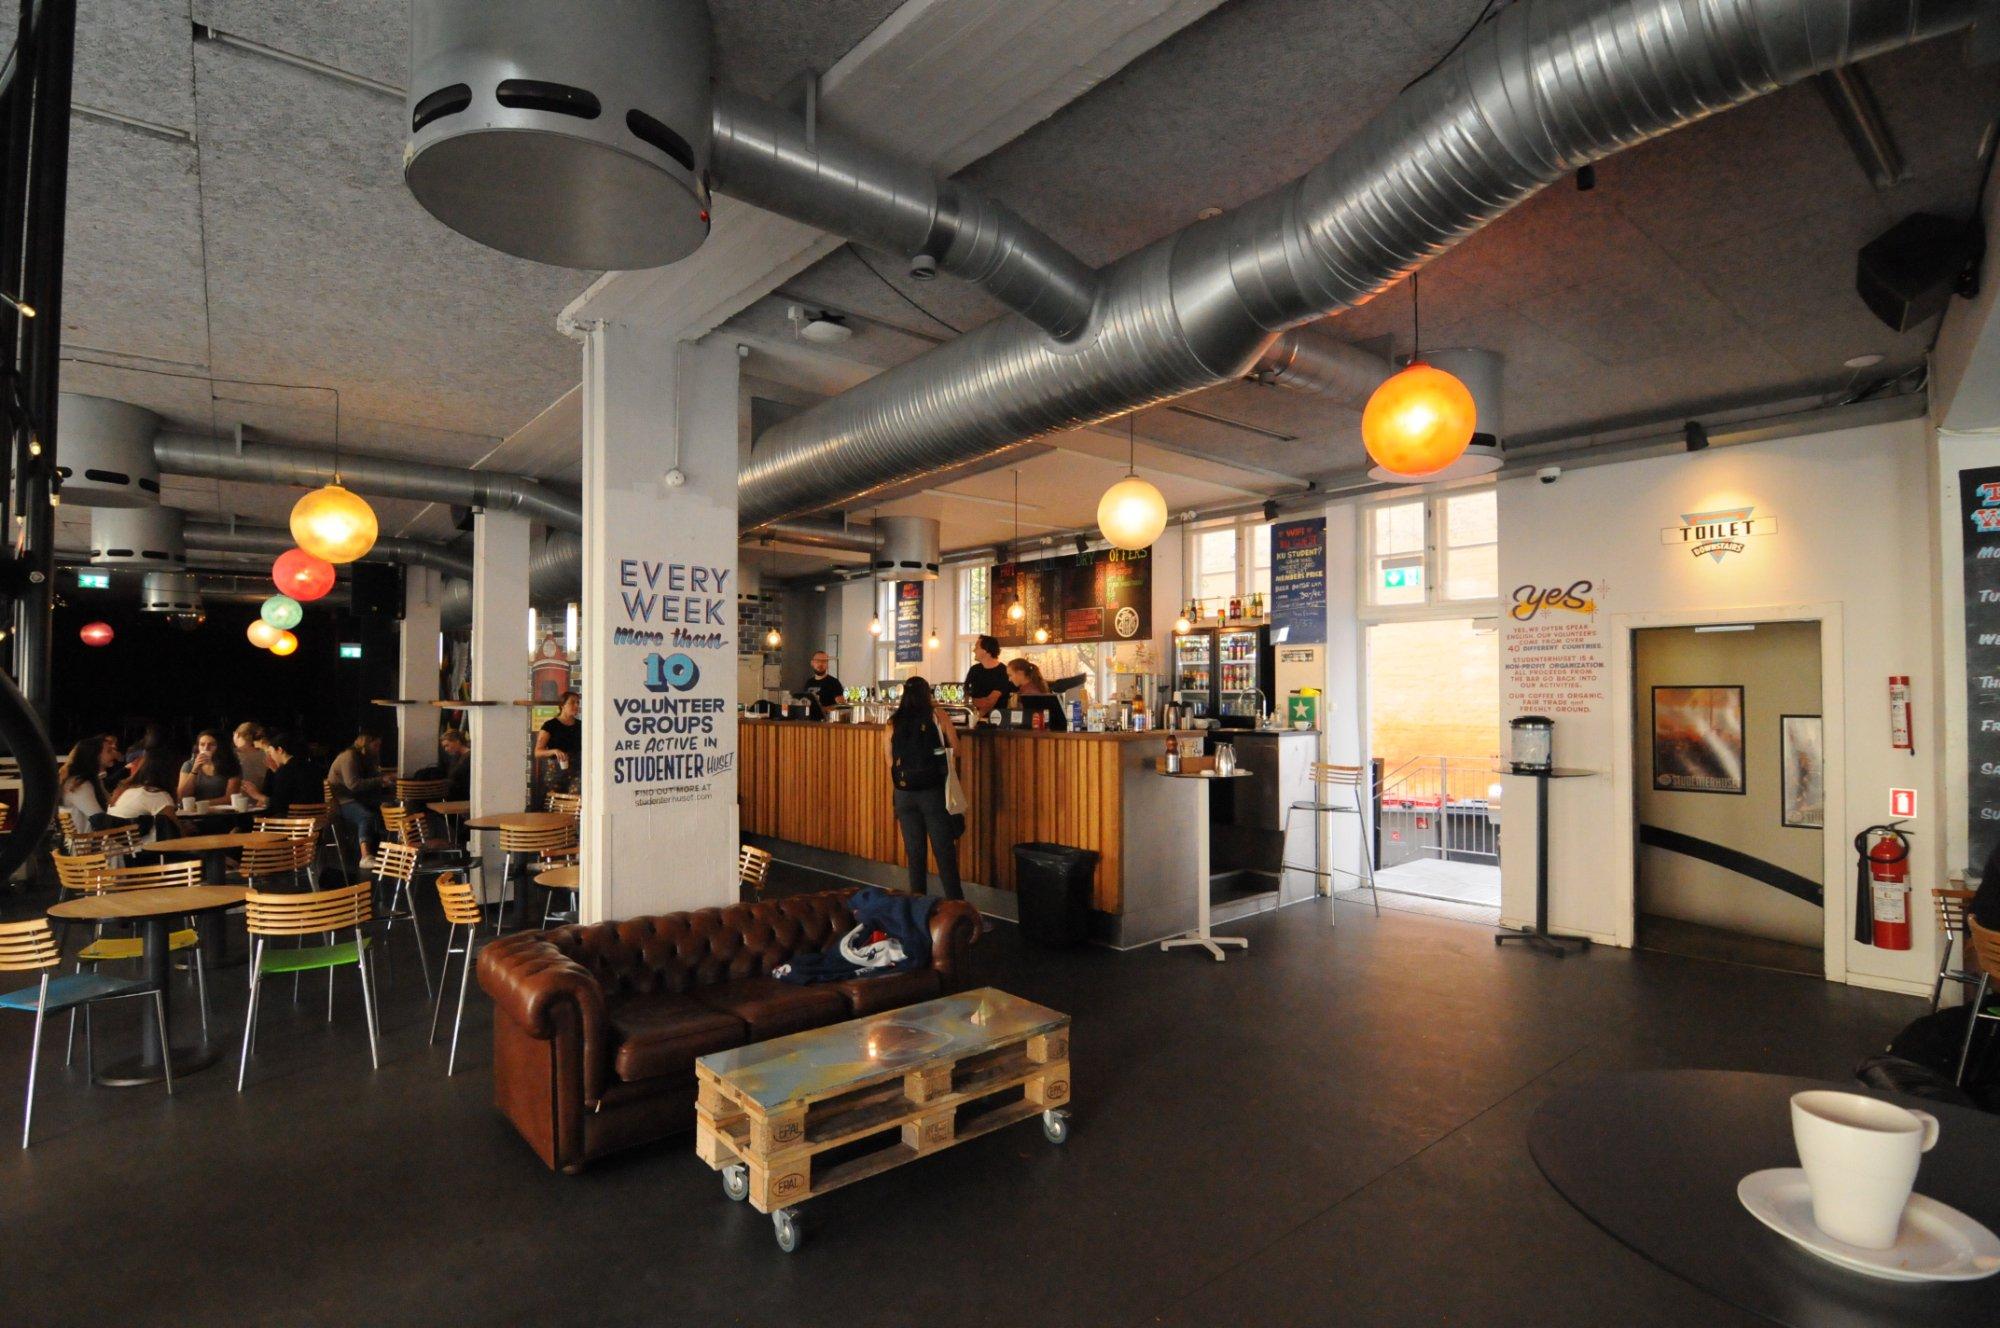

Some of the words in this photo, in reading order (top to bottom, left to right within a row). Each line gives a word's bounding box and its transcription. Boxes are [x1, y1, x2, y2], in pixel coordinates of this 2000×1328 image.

[1680, 520, 1755, 541] TOILET
[1109, 547, 1148, 563] OFFERS
[1692, 542, 1744, 556] DOWNSTAIRS
[621, 559, 730, 593] EVERY
[621, 588, 726, 625] WEEK
[614, 626, 663, 646] more
[671, 628, 729, 649] than
[1554, 630, 1597, 638] VOLUNTEERS
[1513, 655, 1576, 663] STUDENTERHUSET
[643, 653, 700, 692] 10
[613, 696, 725, 716] VOLUNTEER
[625, 716, 713, 735] GROUPS
[615, 740, 640, 751] ARE
[644, 736, 698, 754] ACTIVE
[704, 736, 717, 748] IN
[614, 753, 704, 784] STUDENTER
[707, 752, 735, 774] HUSET
[634, 789, 654, 797] FIND
[656, 787, 673, 795] OUT
[676, 785, 699, 794] MORE
[779, 1177, 799, 1194] EPAL
